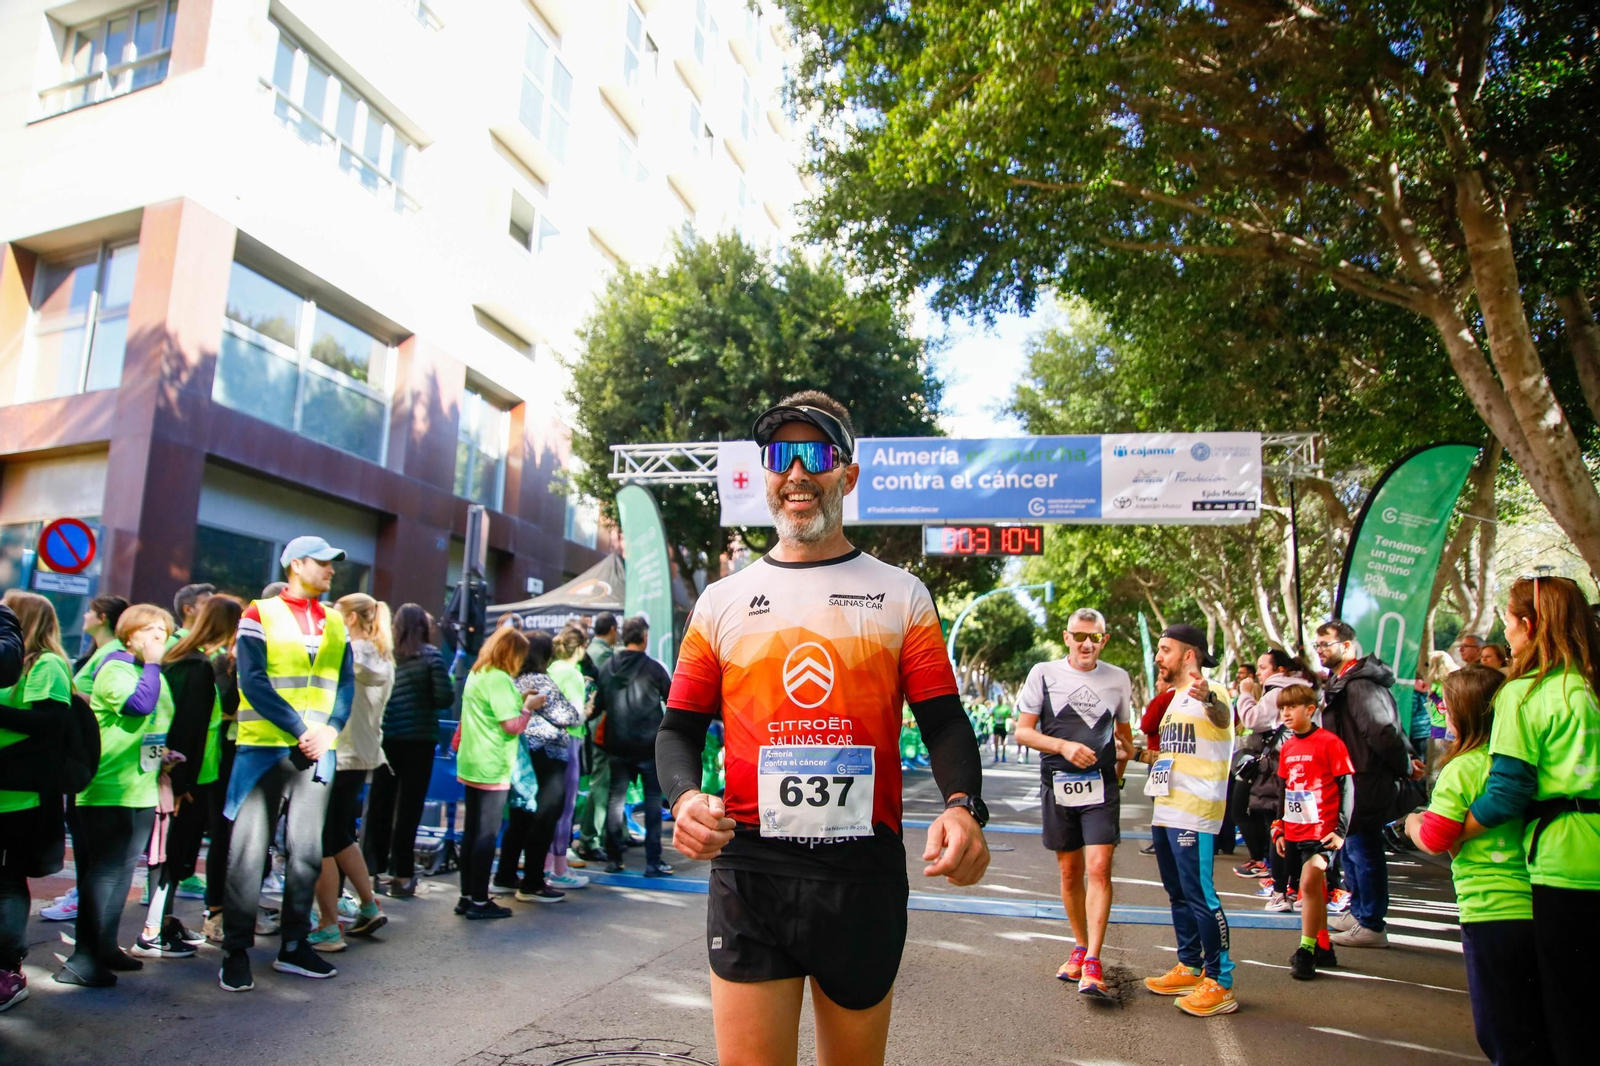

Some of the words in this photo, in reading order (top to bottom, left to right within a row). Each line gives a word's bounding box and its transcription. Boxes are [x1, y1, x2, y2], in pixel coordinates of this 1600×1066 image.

[872, 447, 959, 466] Almería
[1002, 445, 1086, 462] marcha
[1131, 446, 1176, 458] cajamar
[872, 472, 945, 490] contra
[950, 470, 973, 490] el
[978, 470, 1058, 490] cáncer
[1375, 534, 1428, 554] Tenemos
[1370, 548, 1386, 558] un
[1388, 552, 1416, 565] gran
[1368, 560, 1410, 576] camino
[1364, 572, 1386, 584] por
[828, 599, 864, 608] SALINAS
[866, 602, 883, 610] CAR
[748, 608, 770, 616] mobel
[770, 734, 822, 746] SALINAS
[826, 734, 854, 746] CAR
[764, 758, 788, 767] contra
[790, 758, 797, 766] el
[799, 758, 827, 766] cáncer
[1152, 772, 1168, 784] 1500
[780, 776, 854, 806] 637
[1064, 781, 1093, 794] 601
